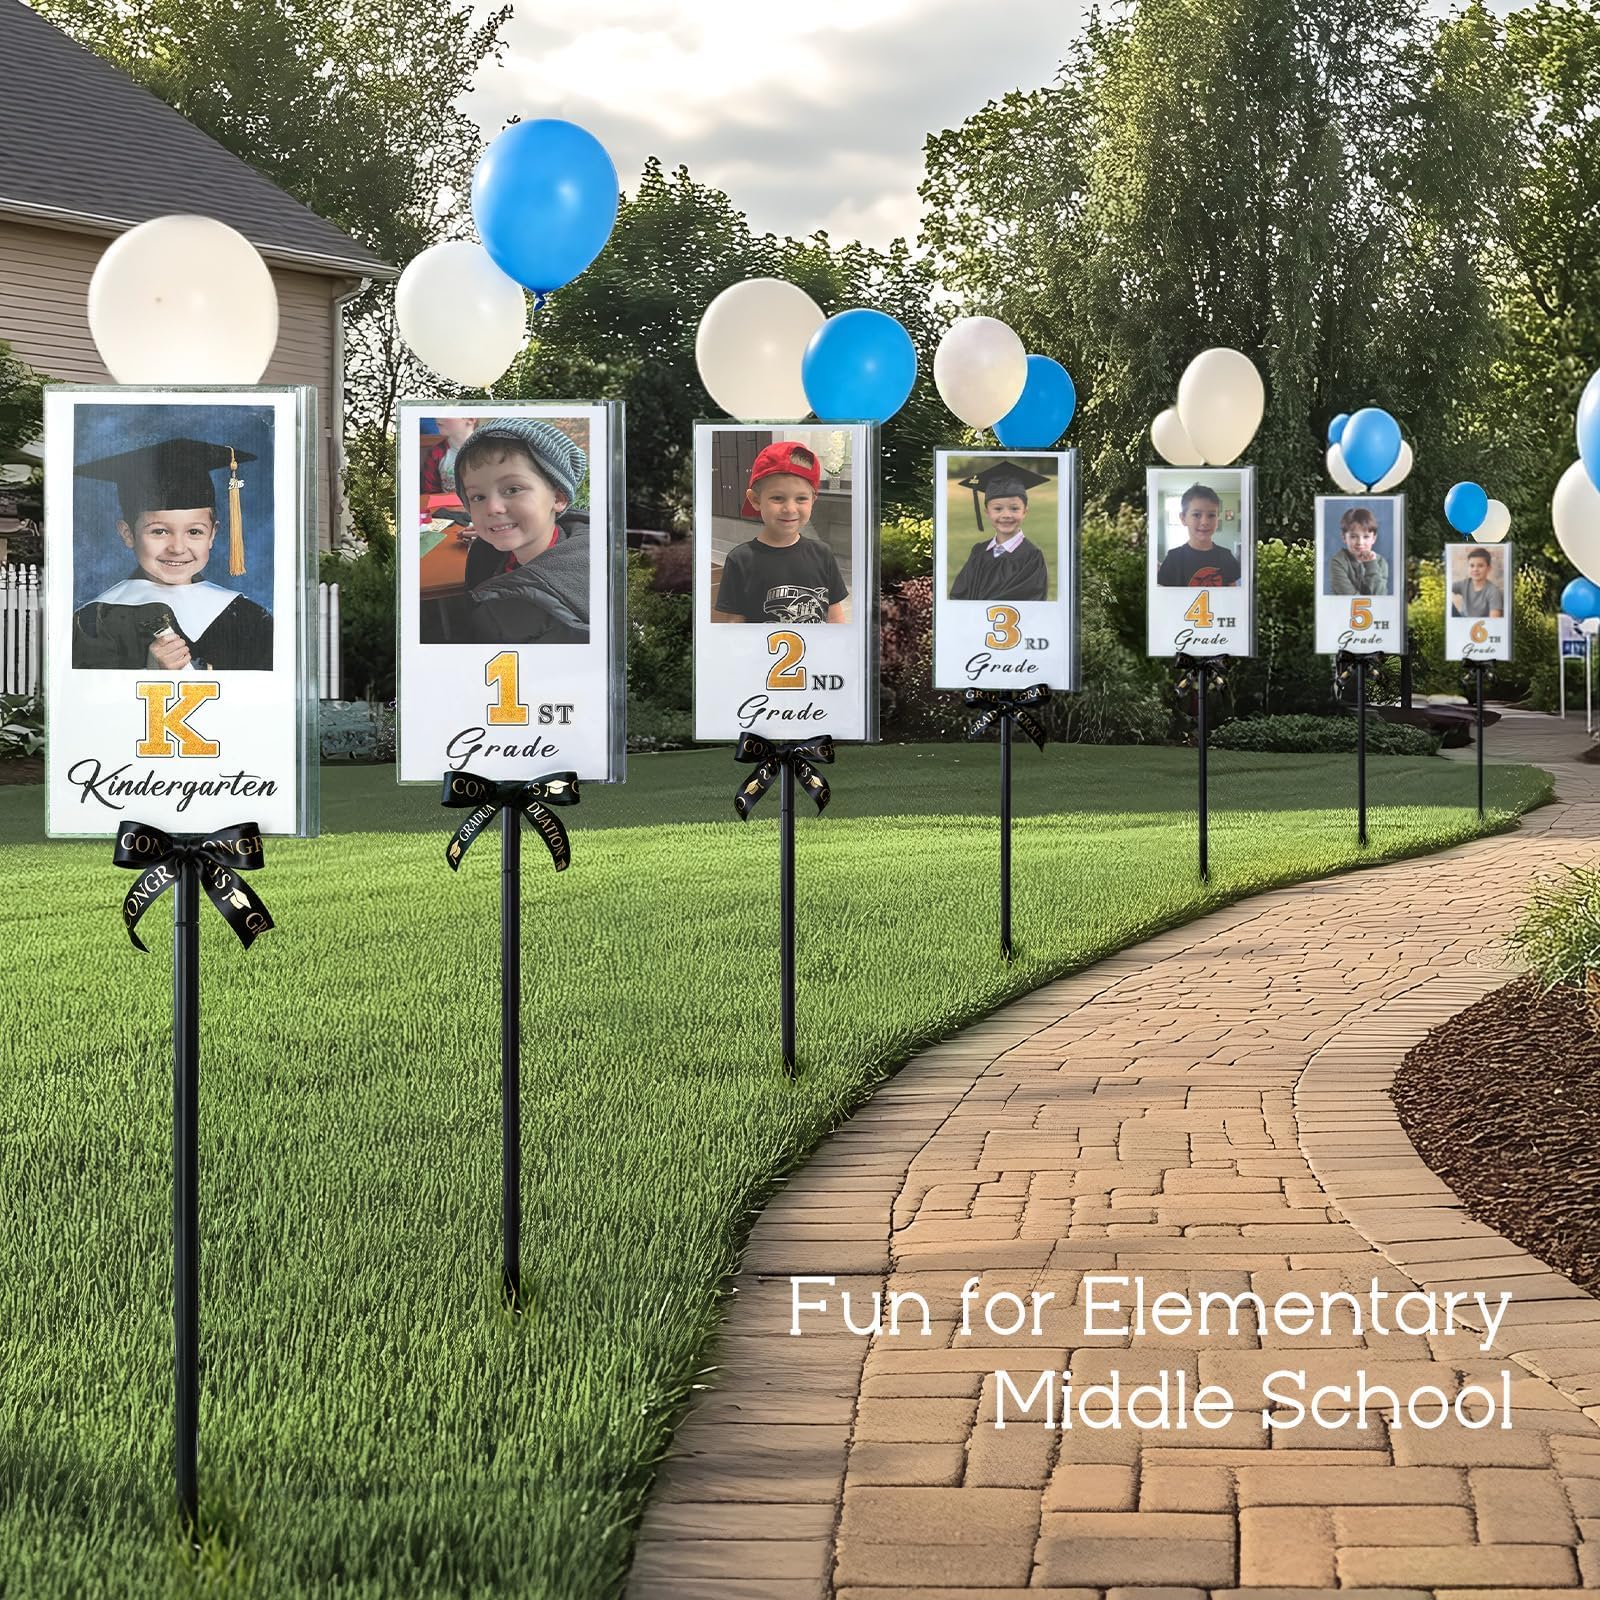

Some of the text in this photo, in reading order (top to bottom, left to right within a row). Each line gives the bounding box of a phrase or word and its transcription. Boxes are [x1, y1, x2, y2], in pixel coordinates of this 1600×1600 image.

[1184, 590, 1236, 628] 4TH
[1350, 598, 1389, 631] 5TH
[985, 605, 1049, 650] 3RD
[1174, 629, 1229, 651] Grade
[1338, 630, 1383, 650] Grade
[1470, 620, 1501, 644] 6TH
[766, 630, 844, 691] 2ND
[965, 653, 1039, 681] Grade
[1462, 643, 1496, 657] Grade
[485, 651, 574, 726] 1ST
[136, 681, 220, 758] K
[737, 695, 828, 729] Grade
[446, 726, 559, 771] Grade
[67, 758, 278, 812] Kindergarten
